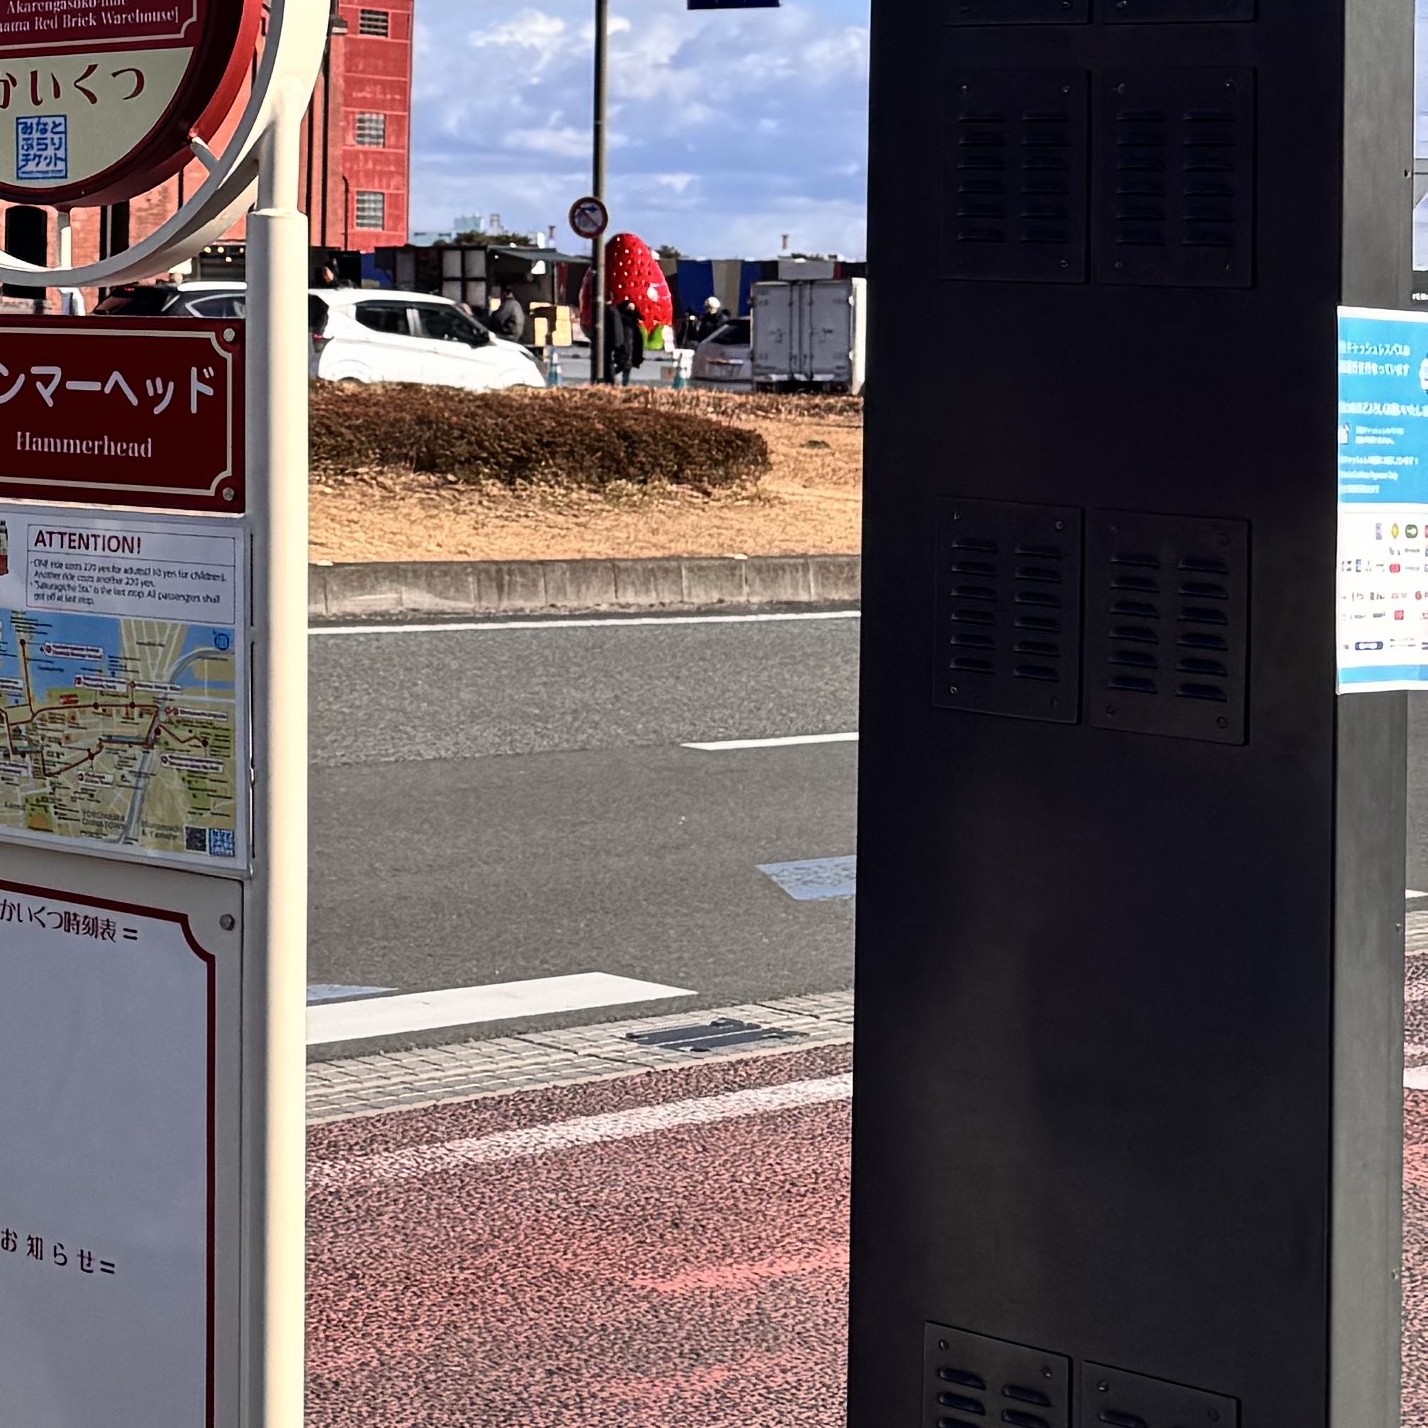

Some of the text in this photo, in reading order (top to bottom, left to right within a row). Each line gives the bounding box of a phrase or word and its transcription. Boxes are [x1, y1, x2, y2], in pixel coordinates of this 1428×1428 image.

[34, 16, 58, 30] Red
[63, 14, 97, 29] Brick
[18, 153, 65, 170] チケット
[16, 430, 153, 459] Hammerhead
[34, 529, 141, 555] ATTENTION!
